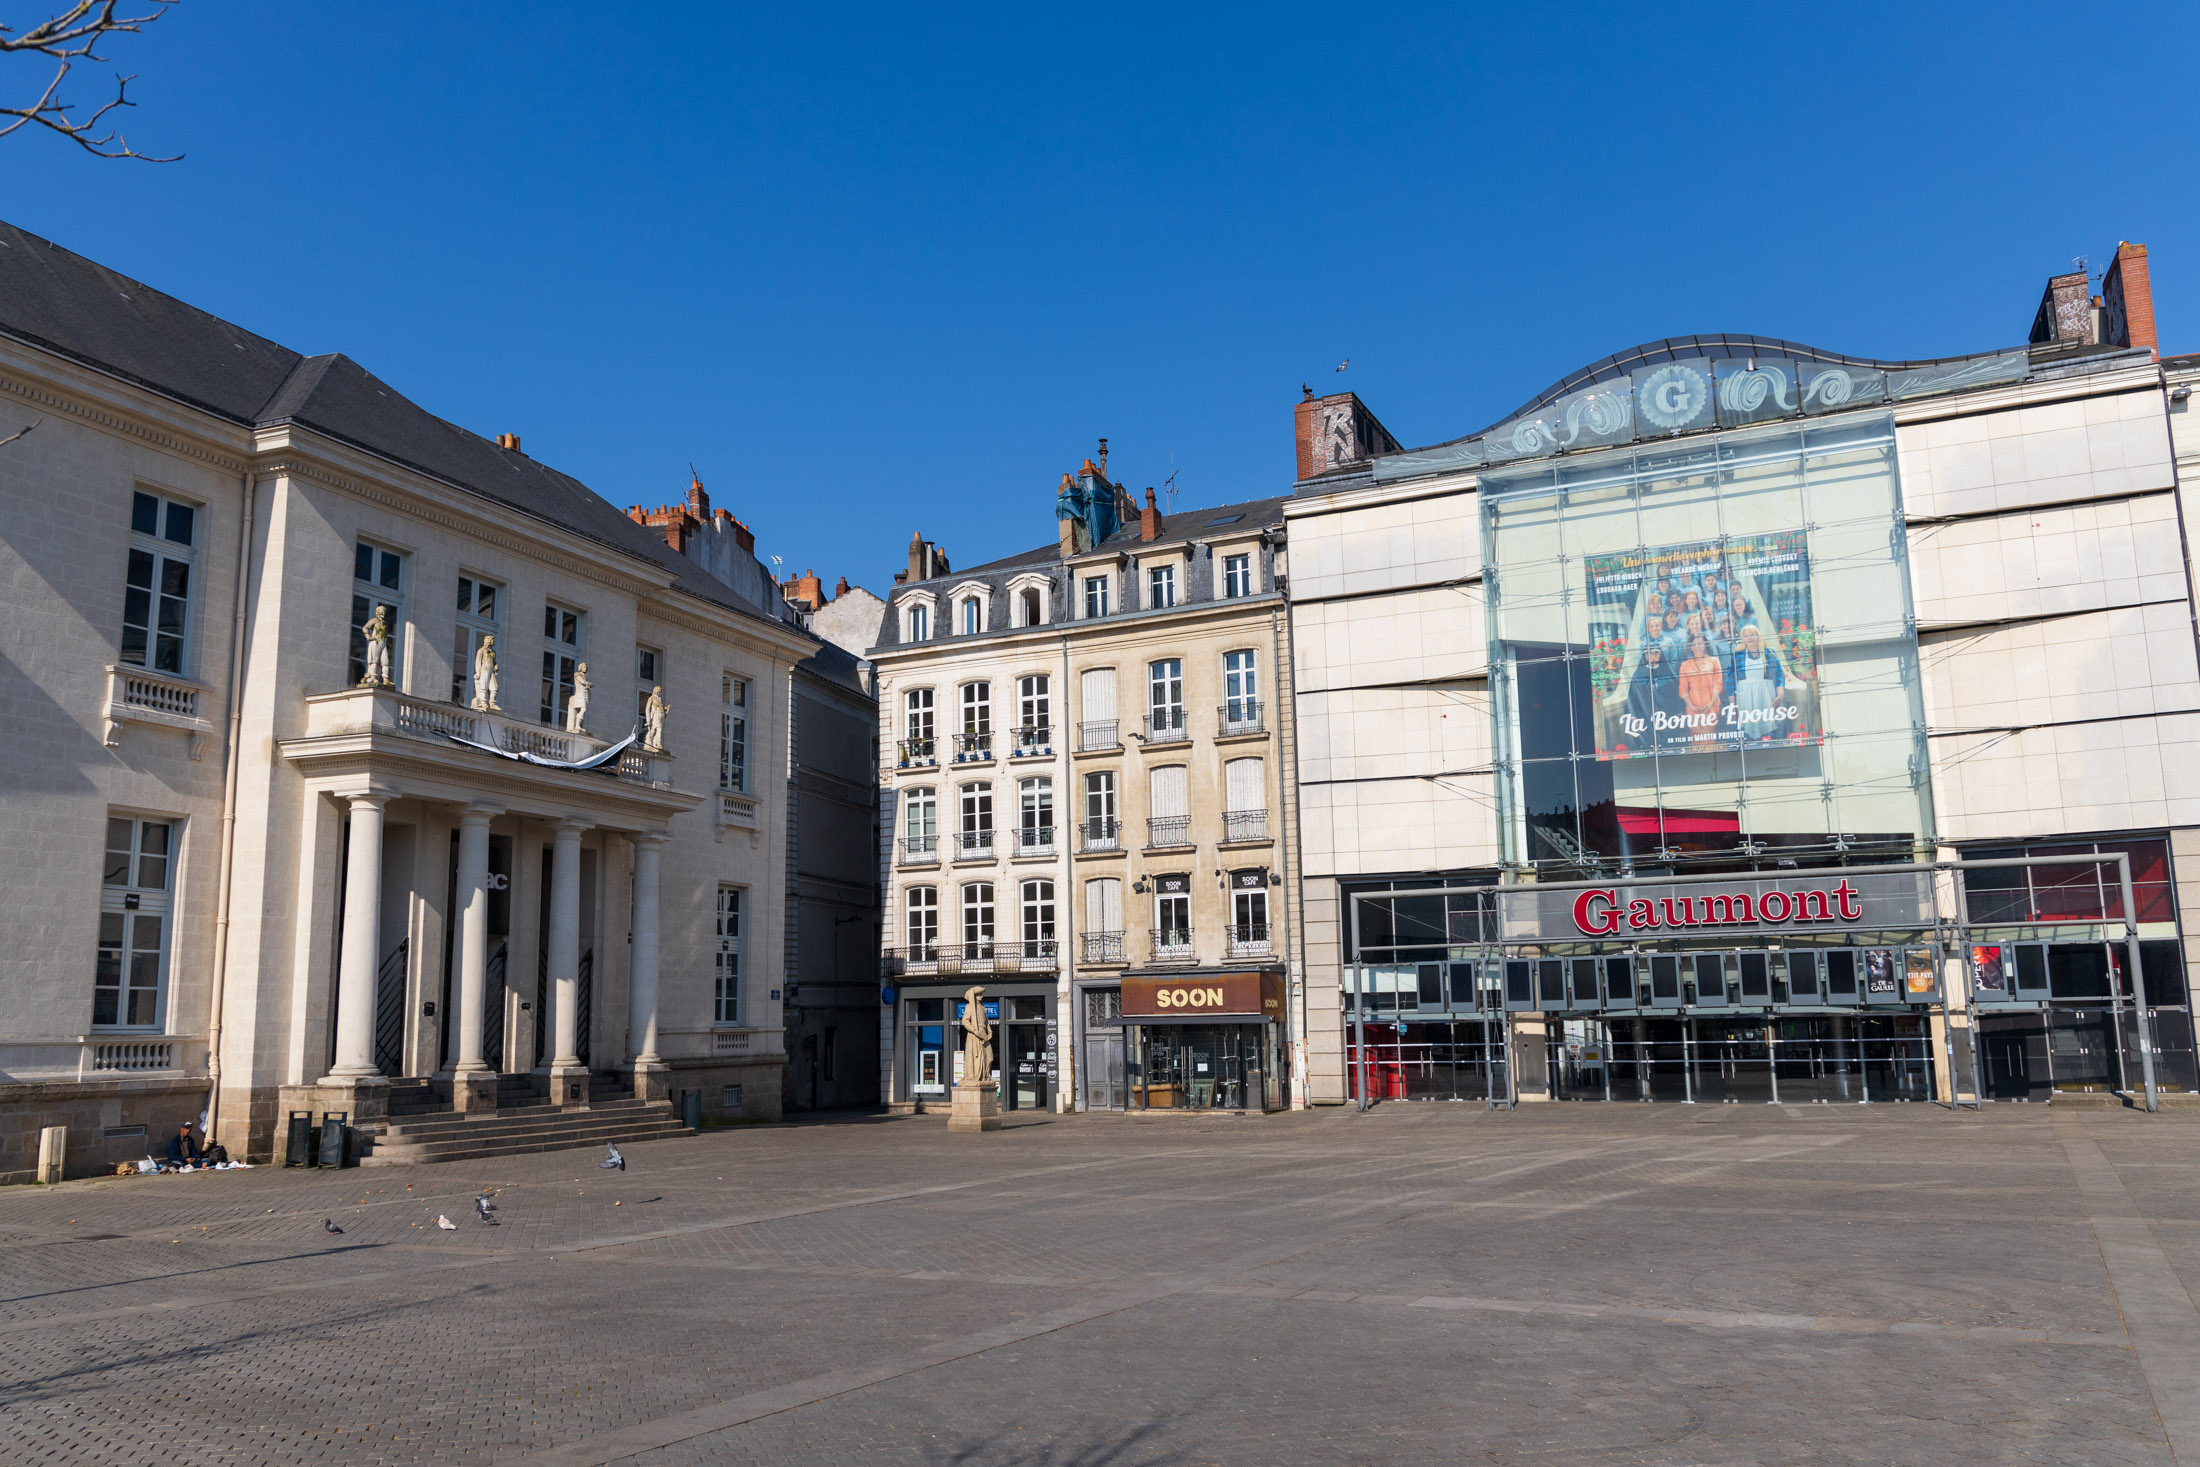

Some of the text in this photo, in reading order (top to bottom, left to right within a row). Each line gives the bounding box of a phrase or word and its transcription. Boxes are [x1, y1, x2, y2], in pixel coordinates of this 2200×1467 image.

[1655, 379, 1691, 414] G
[1619, 712, 1648, 738] La
[1651, 709, 1719, 731] Bonne
[1694, 732, 1717, 742] MARTIN
[1572, 878, 1862, 936] Gaumont
[1920, 971, 1934, 979] PAYS
[1870, 984, 1895, 992] GAULLE
[1157, 987, 1224, 1008] SOON
[1265, 1000, 1278, 1009] SOON
